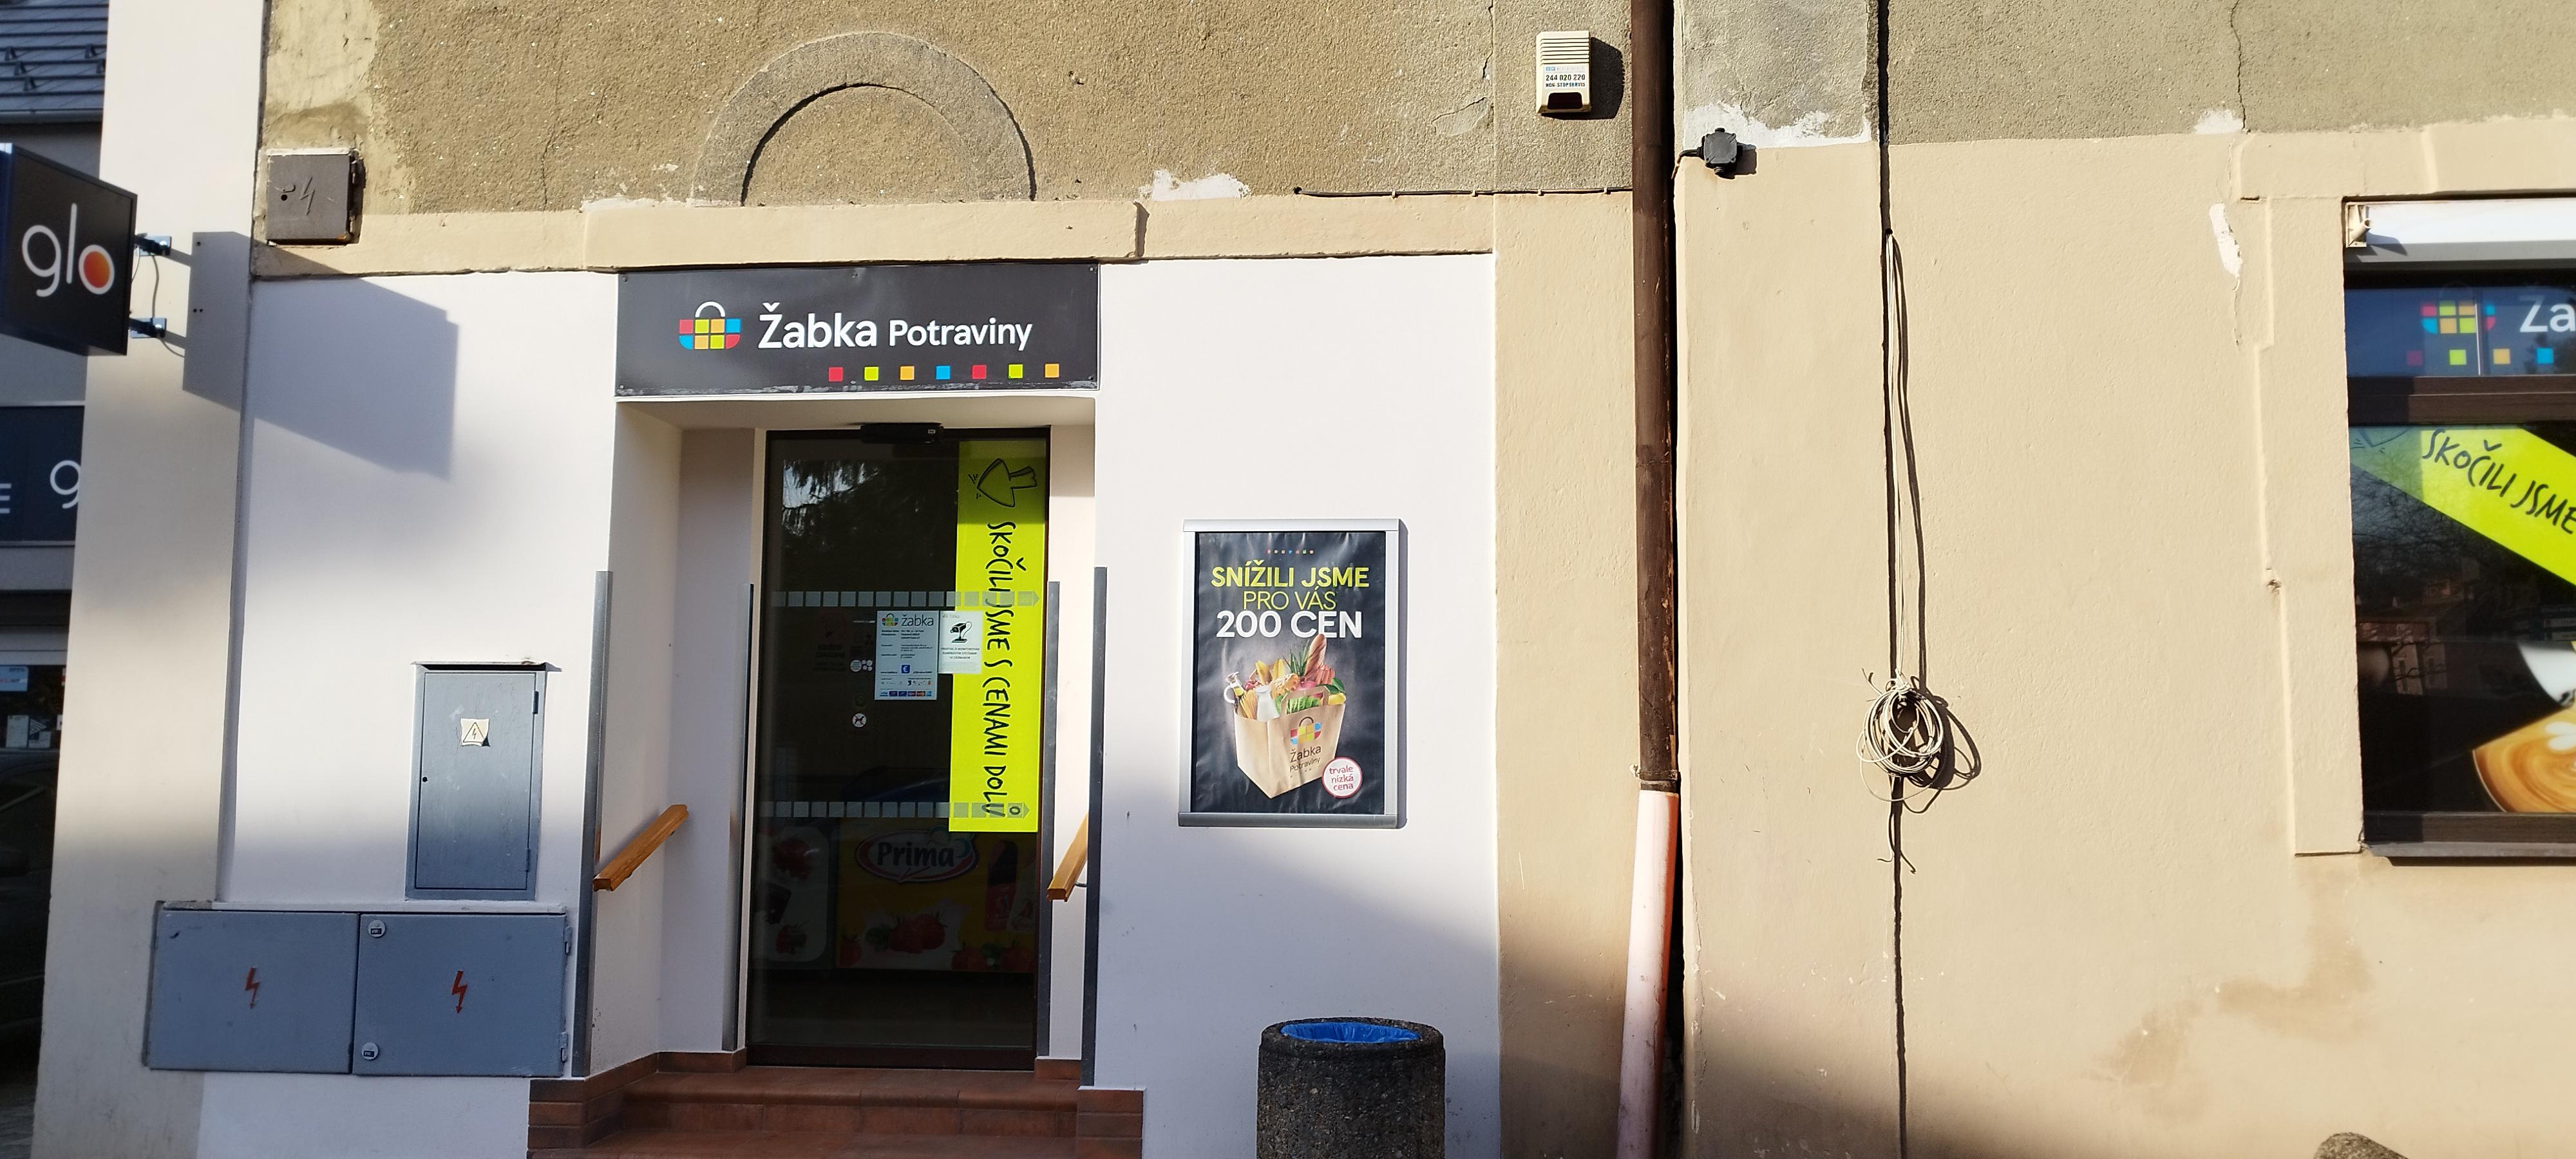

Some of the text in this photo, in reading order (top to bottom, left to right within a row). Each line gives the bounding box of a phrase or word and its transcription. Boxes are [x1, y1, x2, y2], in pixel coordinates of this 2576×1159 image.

[22, 203, 115, 297] glo
[758, 302, 1033, 351] Žabka Potraviny
[2422, 428, 2576, 534] SKOČILI JSME
[985, 522, 1027, 592] SKOČILI
[1211, 560, 1370, 587] SNÍŽILI JSME
[1244, 585, 1336, 610] PRO VÁS
[901, 614, 934, 627] žabka
[985, 598, 1014, 651] JSME
[1216, 610, 1362, 638] 200 CEN
[984, 659, 1013, 668] S
[982, 677, 1011, 755] CENAMI
[1290, 746, 1321, 763] Žabka
[1290, 757, 1321, 773] Potraviny
[1329, 764, 1354, 775] trvale
[1331, 774, 1354, 784] nízká
[1333, 782, 1354, 791] cena
[877, 842, 955, 867] Prima
